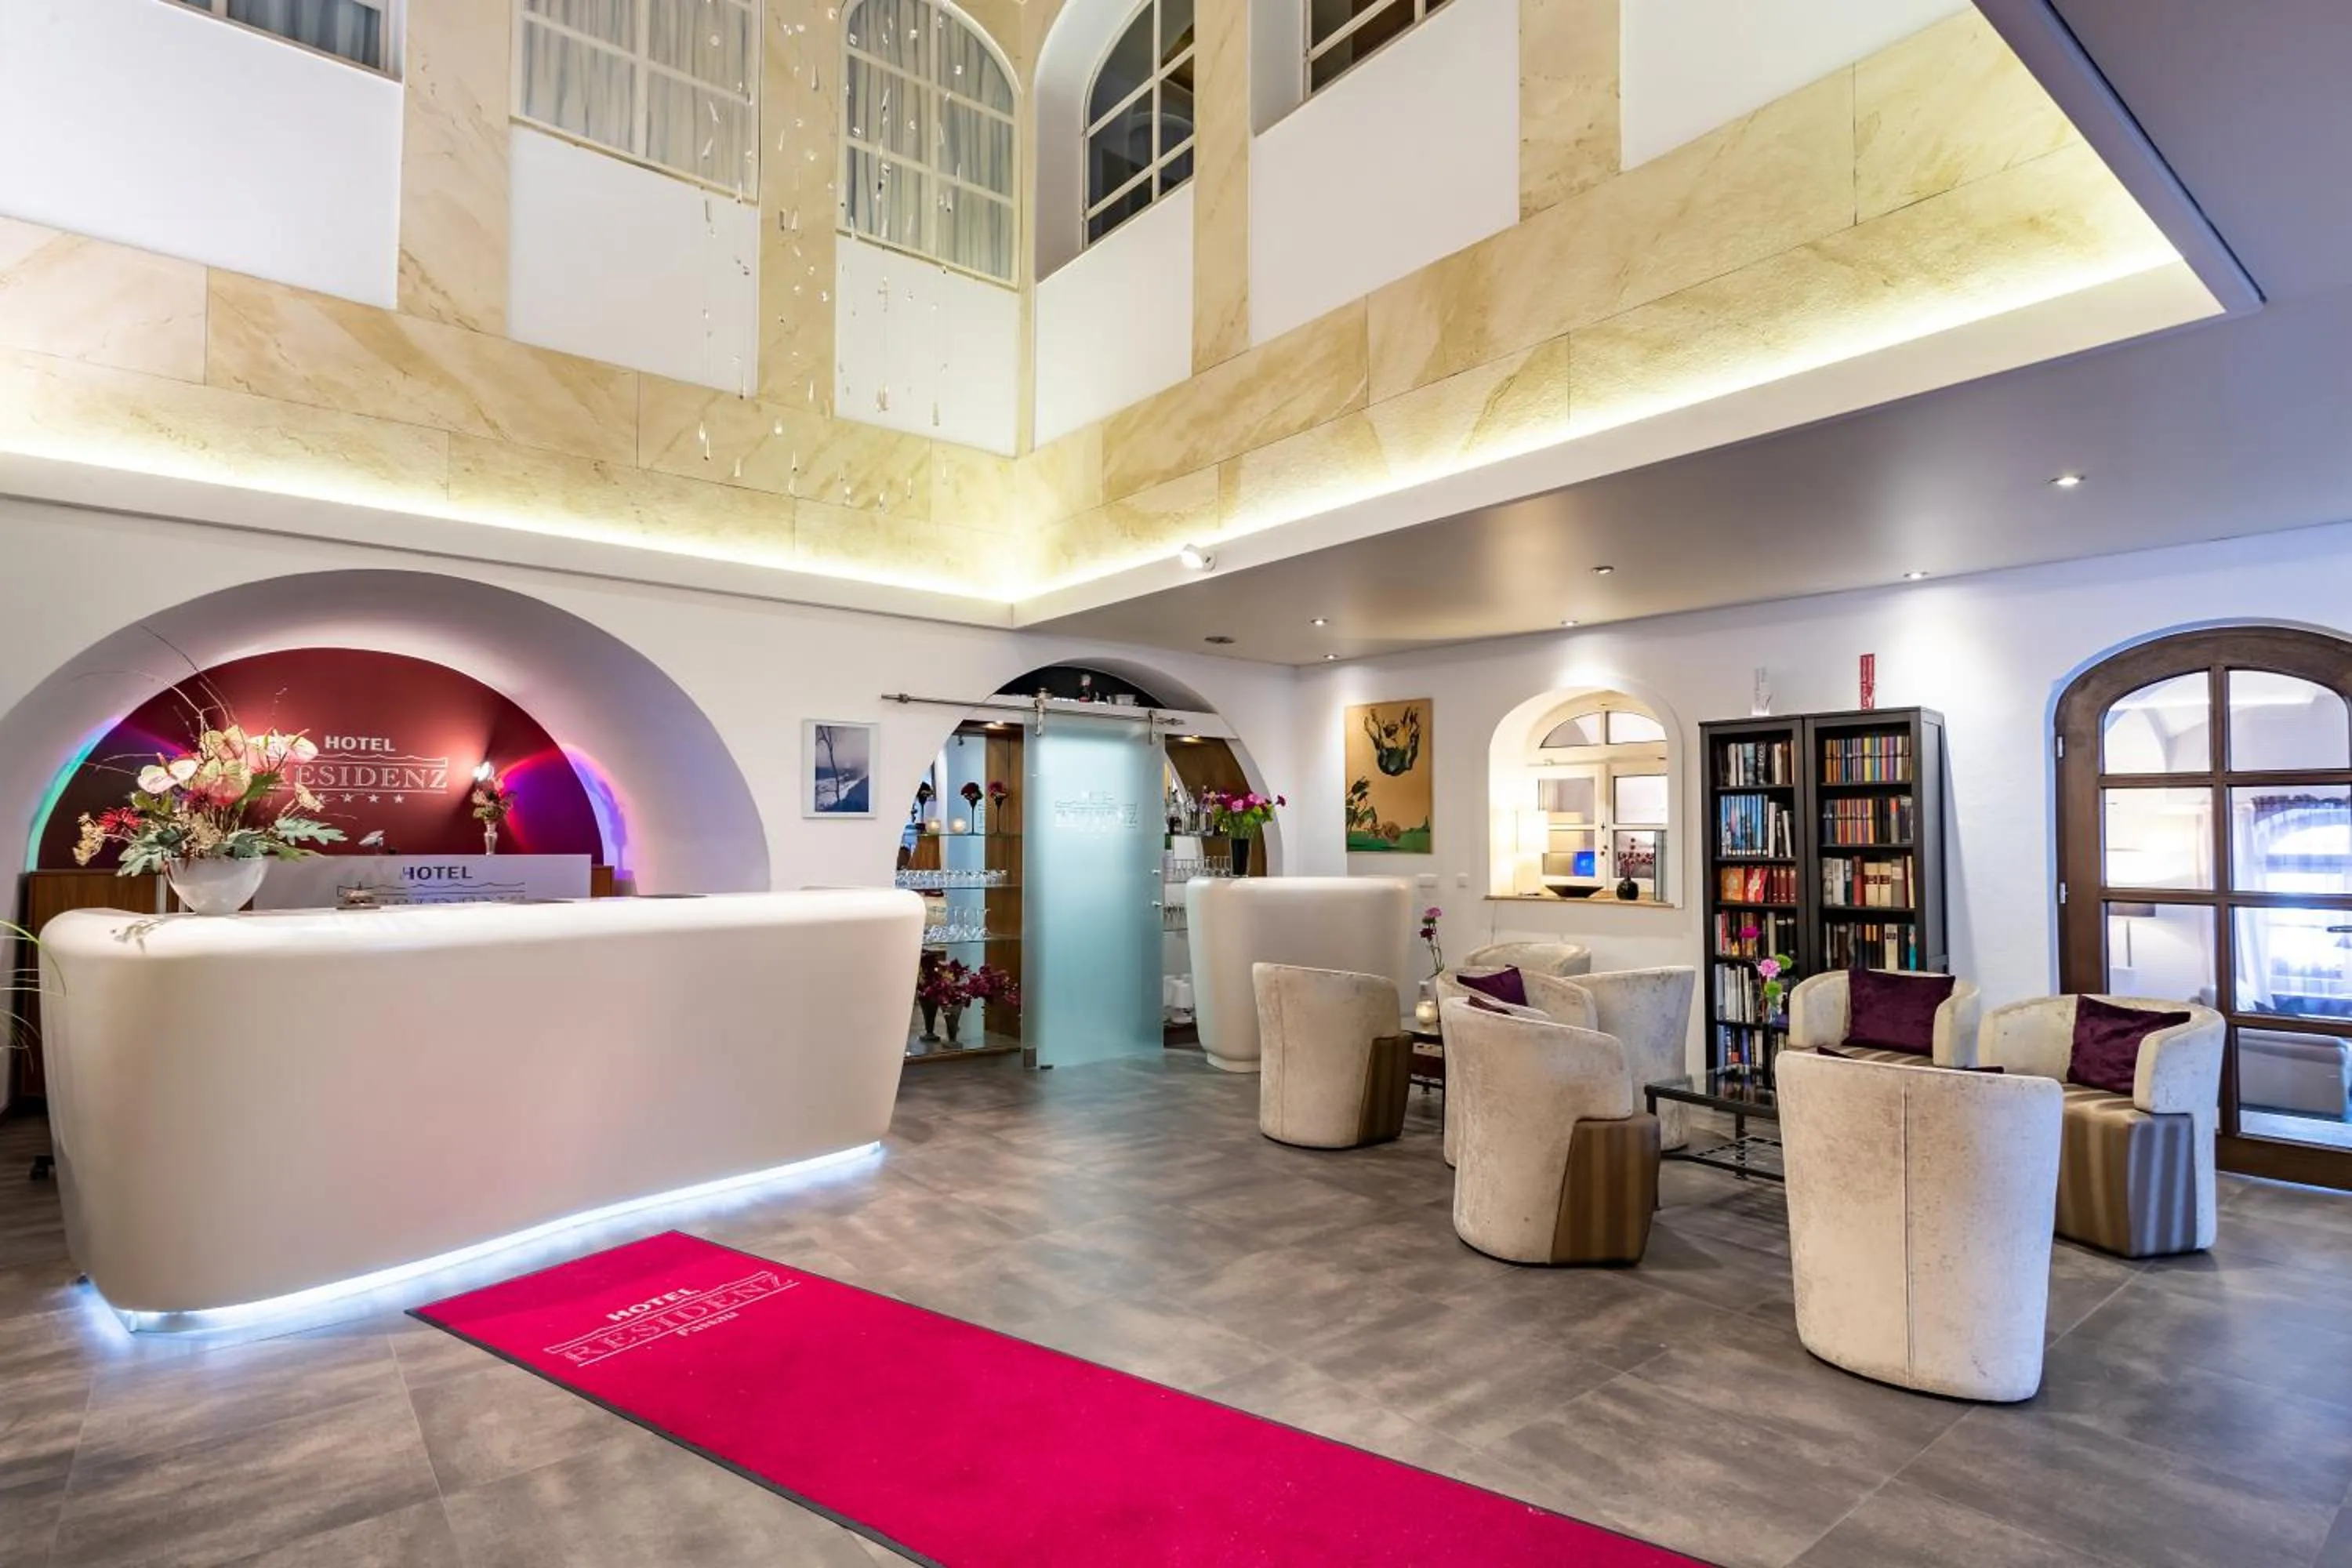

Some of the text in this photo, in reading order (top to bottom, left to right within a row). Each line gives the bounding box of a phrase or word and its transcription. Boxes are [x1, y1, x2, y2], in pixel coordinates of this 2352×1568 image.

[325, 735, 397, 752] HOTEL
[401, 866, 474, 880] HOTEL
[606, 1288, 701, 1321] HOTEL
[564, 1273, 793, 1362] RESIDENZ
